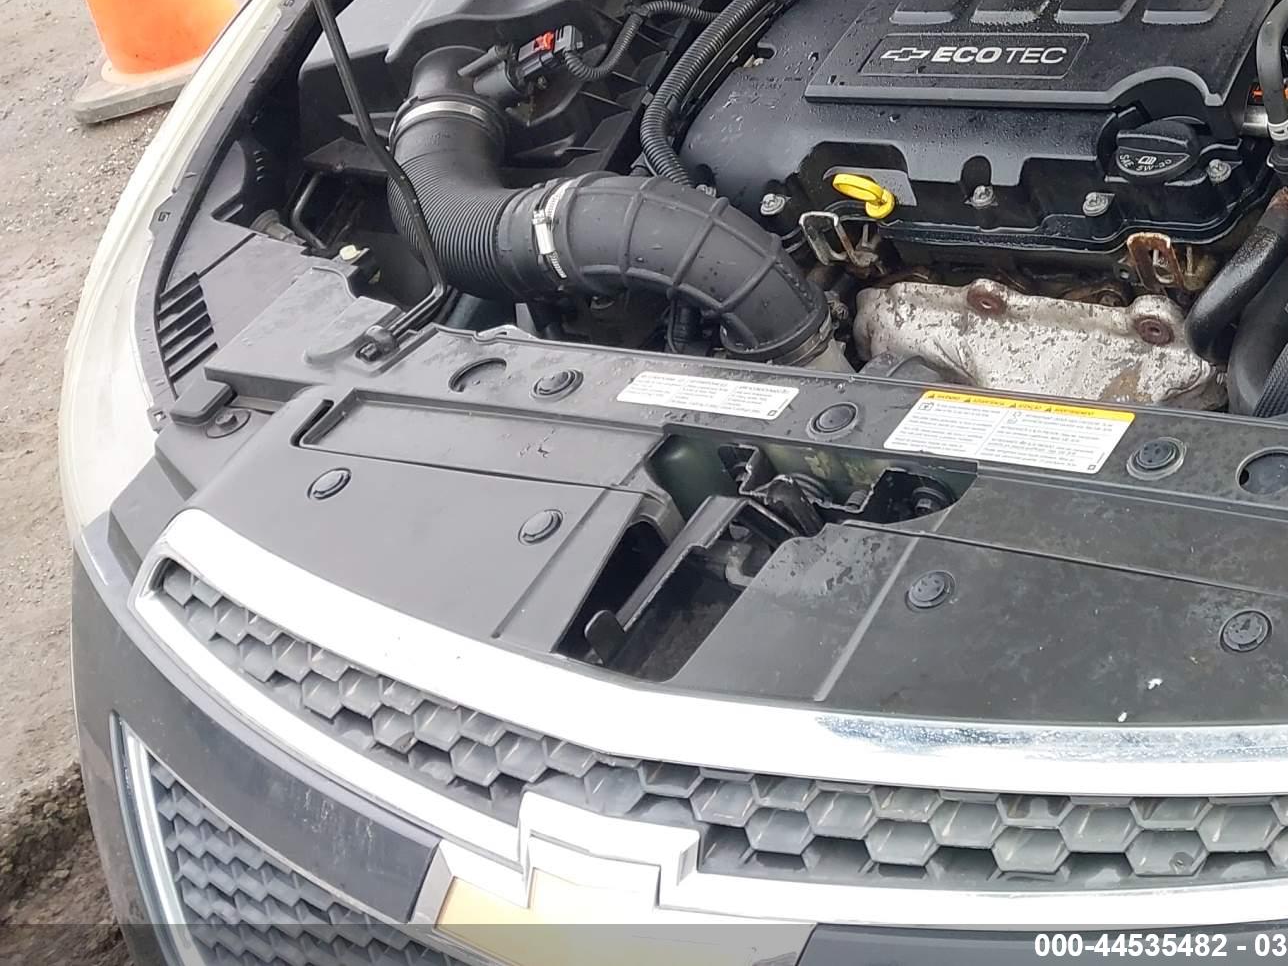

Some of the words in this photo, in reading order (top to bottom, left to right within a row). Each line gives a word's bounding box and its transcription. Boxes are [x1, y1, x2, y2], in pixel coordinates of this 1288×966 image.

[931, 46, 1067, 64] ECOTEC
[1119, 154, 1134, 168] SAE
[1136, 159, 1172, 171] 5W-30
